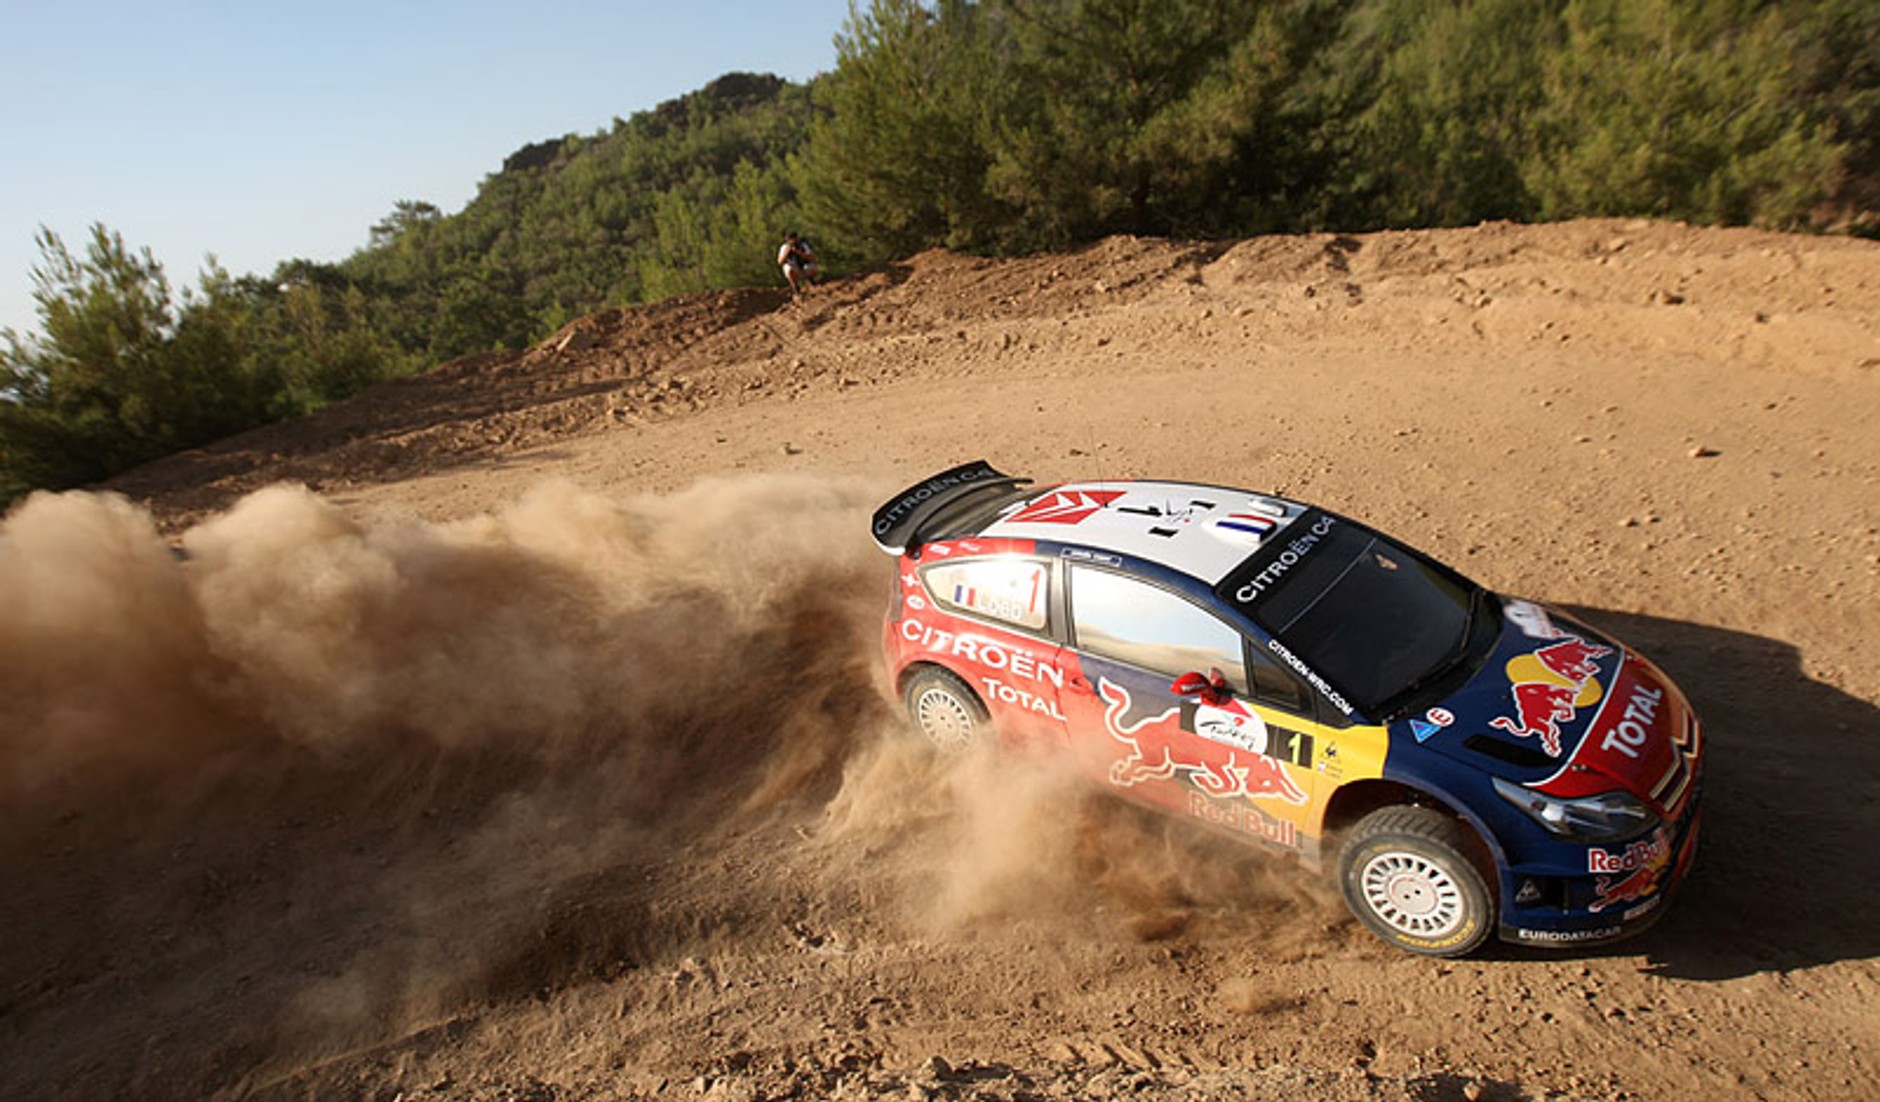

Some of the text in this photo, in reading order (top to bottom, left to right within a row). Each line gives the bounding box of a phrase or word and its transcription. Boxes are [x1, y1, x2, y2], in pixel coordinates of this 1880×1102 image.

[874, 477, 961, 535] CITROËN
[1030, 568, 1041, 613] 1
[1235, 534, 1319, 603] CITROËN
[901, 619, 1064, 688] CITROËN
[982, 677, 1067, 721] TOTAL
[1601, 685, 1663, 758] TOTAL
[1287, 731, 1302, 766] 1
[1188, 790, 1296, 847] Red Bull
[1588, 844, 1636, 873] Red
